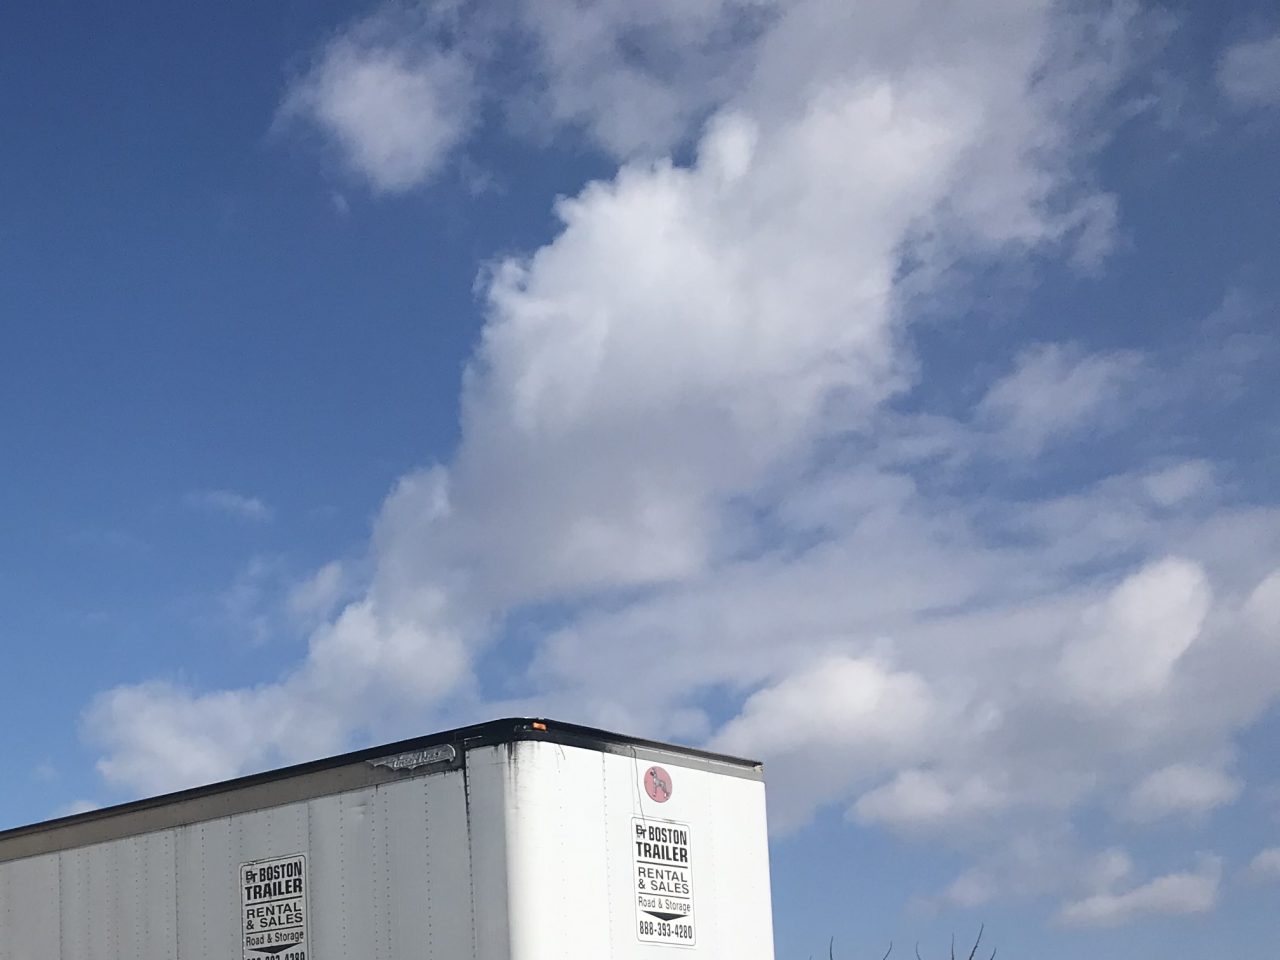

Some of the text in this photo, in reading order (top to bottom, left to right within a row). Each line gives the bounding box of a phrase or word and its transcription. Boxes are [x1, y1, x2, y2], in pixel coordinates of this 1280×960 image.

[648, 825, 687, 845] BOSTON
[636, 841, 688, 863] TRAILER
[259, 861, 302, 882] BOSTON
[638, 866, 688, 883] RENTAL
[245, 878, 303, 900] TRAILER
[638, 879, 689, 894] & SALES
[246, 902, 302, 919] RENTAL
[638, 896, 691, 914] Road & Storage
[246, 912, 303, 930] & SALES
[639, 920, 693, 939] 888-393-4280
[246, 931, 304, 946] Road & Storage
